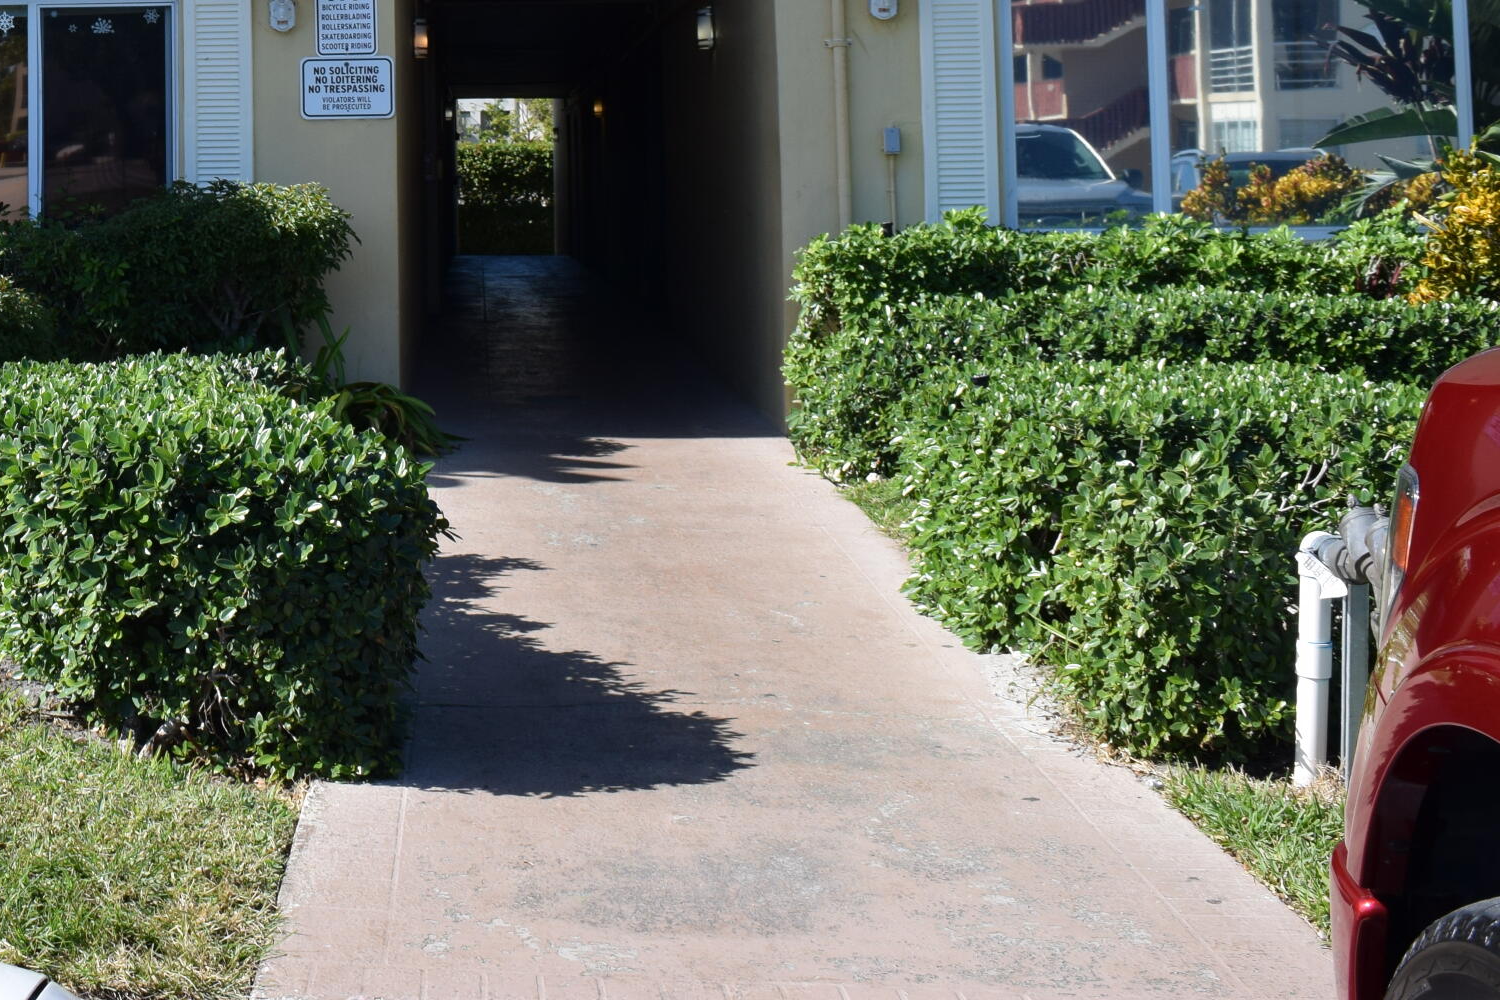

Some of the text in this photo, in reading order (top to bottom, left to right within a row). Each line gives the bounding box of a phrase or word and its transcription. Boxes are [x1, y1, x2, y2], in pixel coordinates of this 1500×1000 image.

[322, 3, 347, 11] BICYCLE
[313, 65, 379, 75] NO SOLICITING
[315, 75, 378, 84] NO LOITERING
[308, 84, 385, 93] NO TRESPASSING
